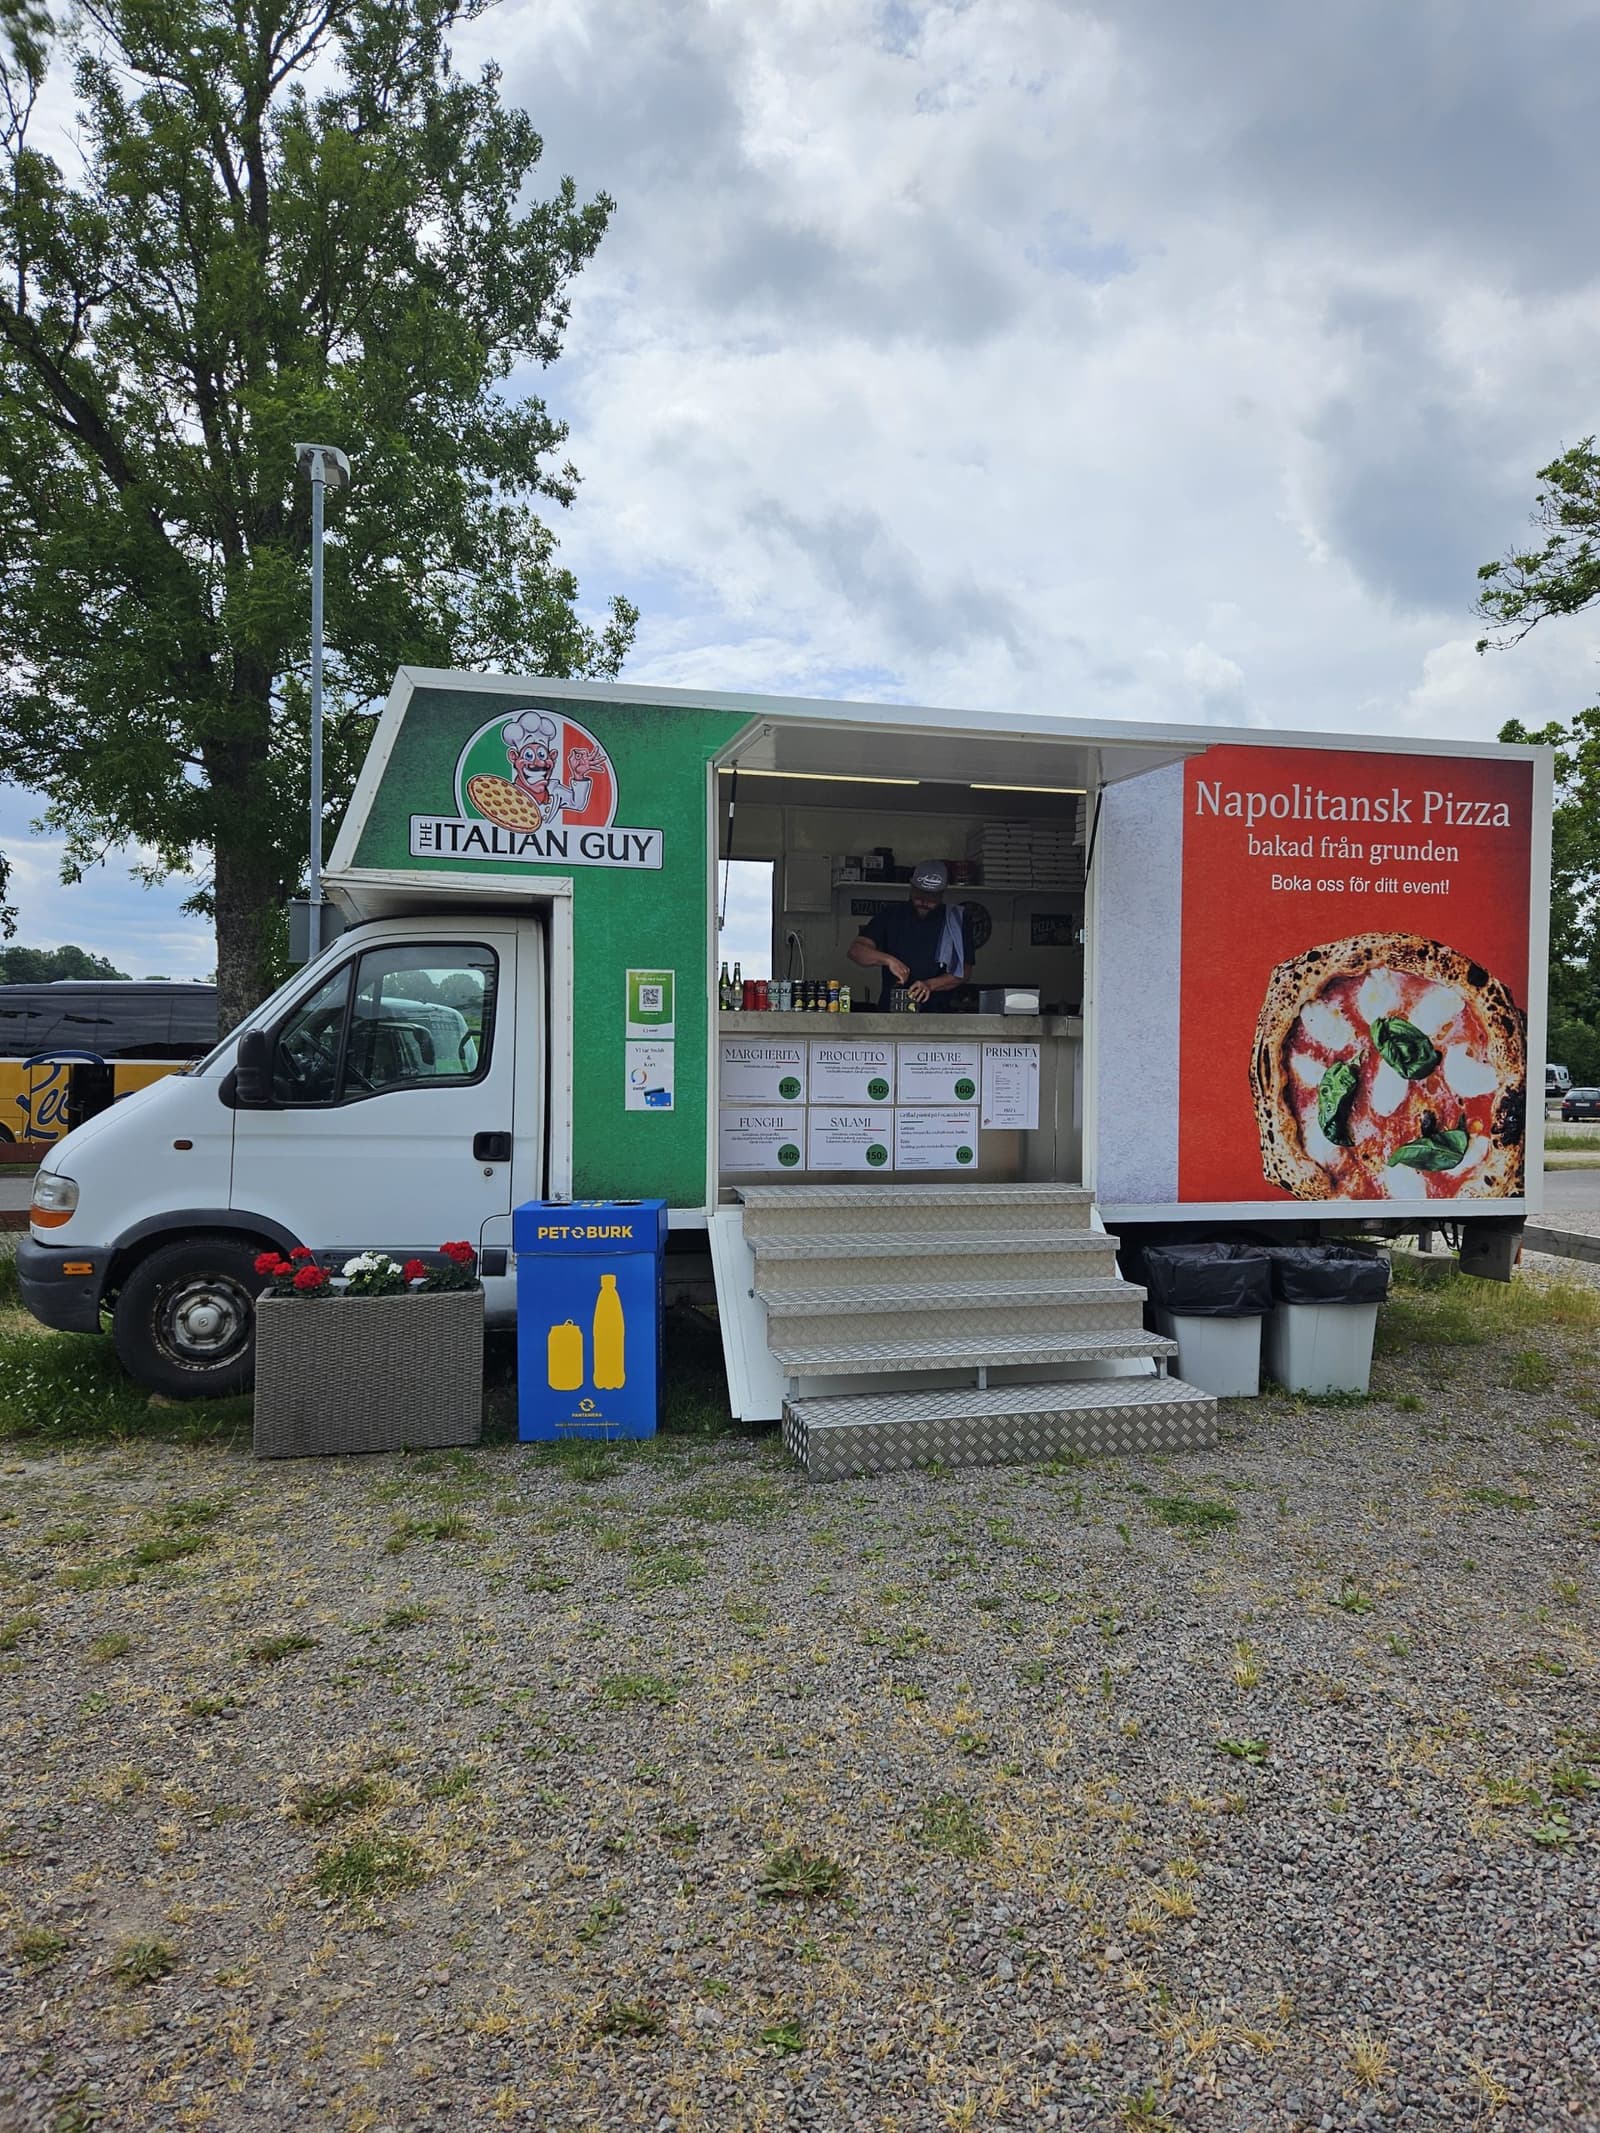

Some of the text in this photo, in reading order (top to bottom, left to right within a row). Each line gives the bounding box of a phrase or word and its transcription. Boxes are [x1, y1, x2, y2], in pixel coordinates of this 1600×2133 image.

[1195, 781, 1511, 827] Napolitansk Pizza
[419, 822, 653, 862] THE ITALIAN GUY
[1248, 834, 1459, 865] bakad från grunden
[1271, 874, 1450, 895] Boka oss för ditt event!
[725, 1048, 800, 1061] MARGHERITA
[819, 1050, 885, 1062] PROCIUTTO
[917, 1051, 962, 1062] CHEVRE
[985, 1047, 1038, 1058] PRISLISTA
[739, 1117, 783, 1128] FUNGHI
[830, 1117, 871, 1128] SALAMI
[538, 1225, 633, 1239] PET BURK
